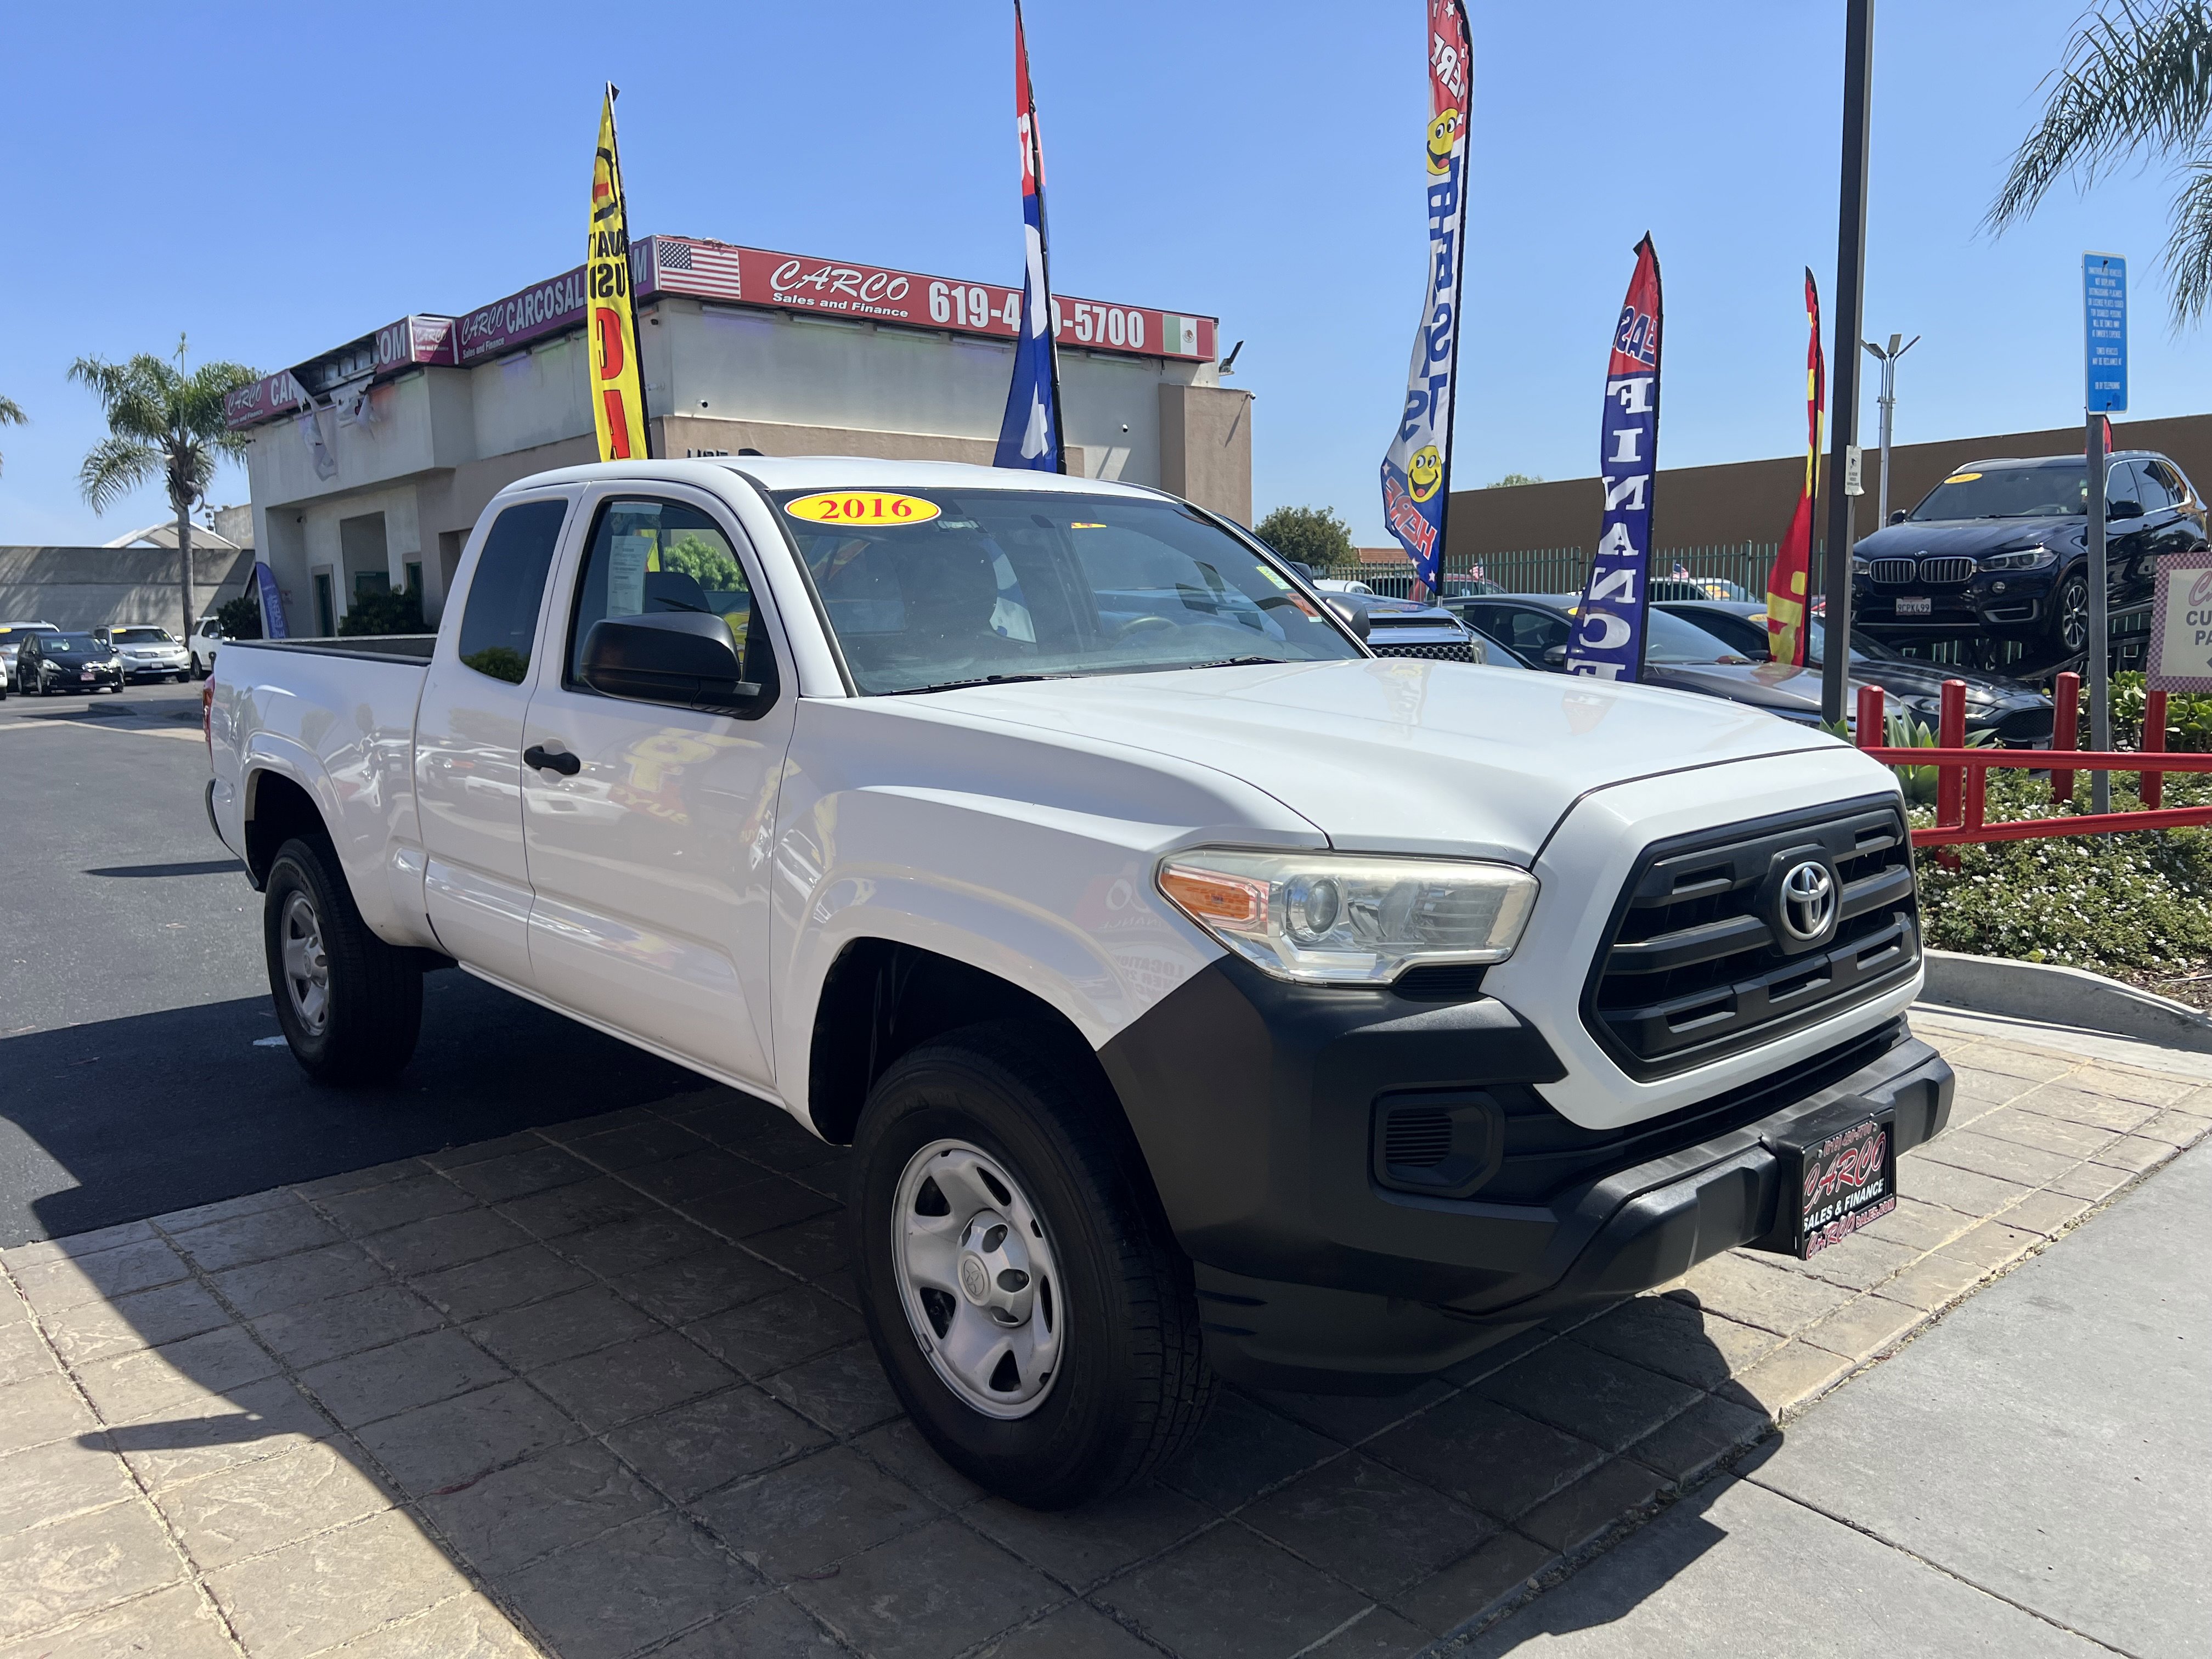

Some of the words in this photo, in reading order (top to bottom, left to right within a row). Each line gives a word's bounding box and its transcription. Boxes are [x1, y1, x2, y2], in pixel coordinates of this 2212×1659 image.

[770, 260, 910, 302] CARCO
[772, 292, 815, 307] Sales
[820, 299, 848, 311] and
[851, 302, 909, 319] Finance
[415, 328, 447, 343] CARCO
[461, 304, 504, 346] CARCO
[486, 336, 504, 350] Finance
[228, 383, 262, 415] CARCO
[819, 498, 912, 519] 2016
[2186, 610, 2212, 626] CU
[1804, 1131, 1886, 1215] CARCO
[1804, 1204, 1833, 1232] SALES
[1835, 1200, 1842, 1216] &
[1844, 1178, 1884, 1210] FINANCE
